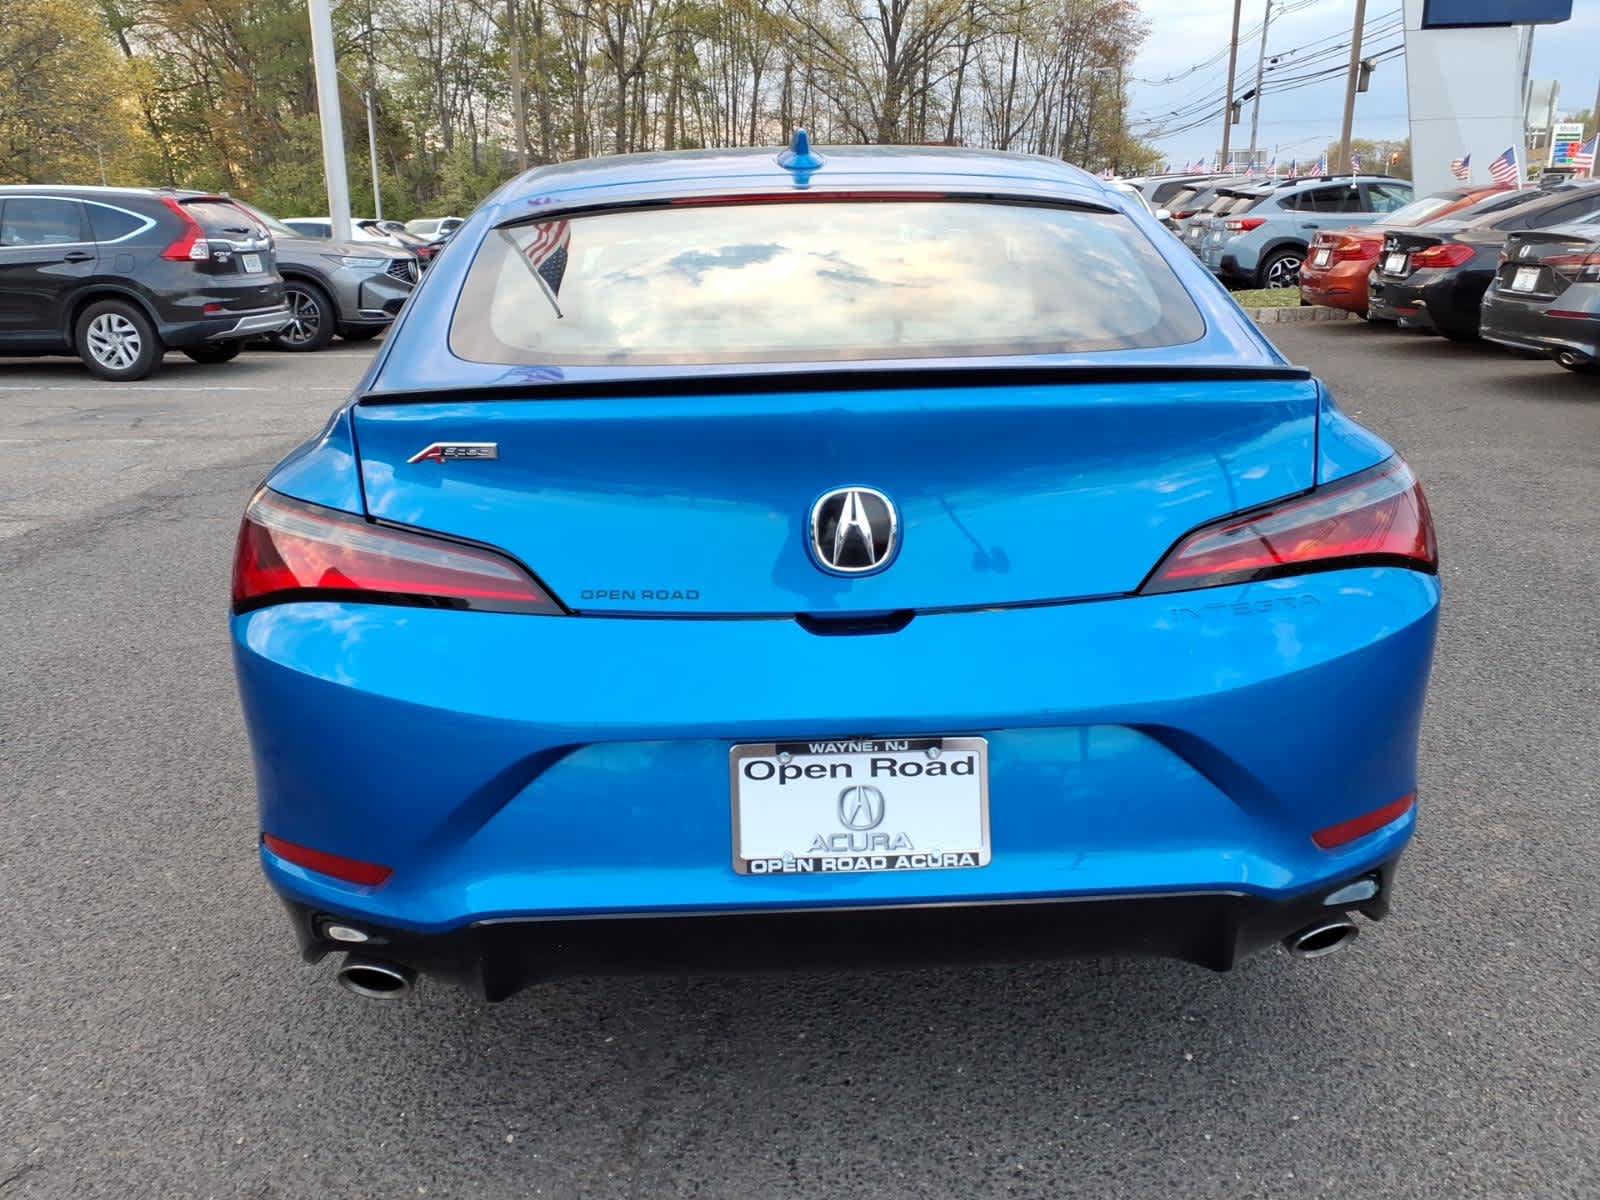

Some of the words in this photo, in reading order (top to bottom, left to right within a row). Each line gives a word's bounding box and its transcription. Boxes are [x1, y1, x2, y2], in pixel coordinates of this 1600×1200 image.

[580, 589, 636, 600] OPEN
[641, 589, 700, 600] ROAD
[808, 741, 878, 754] WAYNE,
[885, 740, 909, 751] NJ
[744, 760, 852, 785] Open
[870, 755, 974, 777] Road
[806, 832, 914, 853] ACURA
[750, 858, 814, 873] OPEN
[821, 856, 887, 871] ROAD
[894, 853, 975, 869] ACURA
